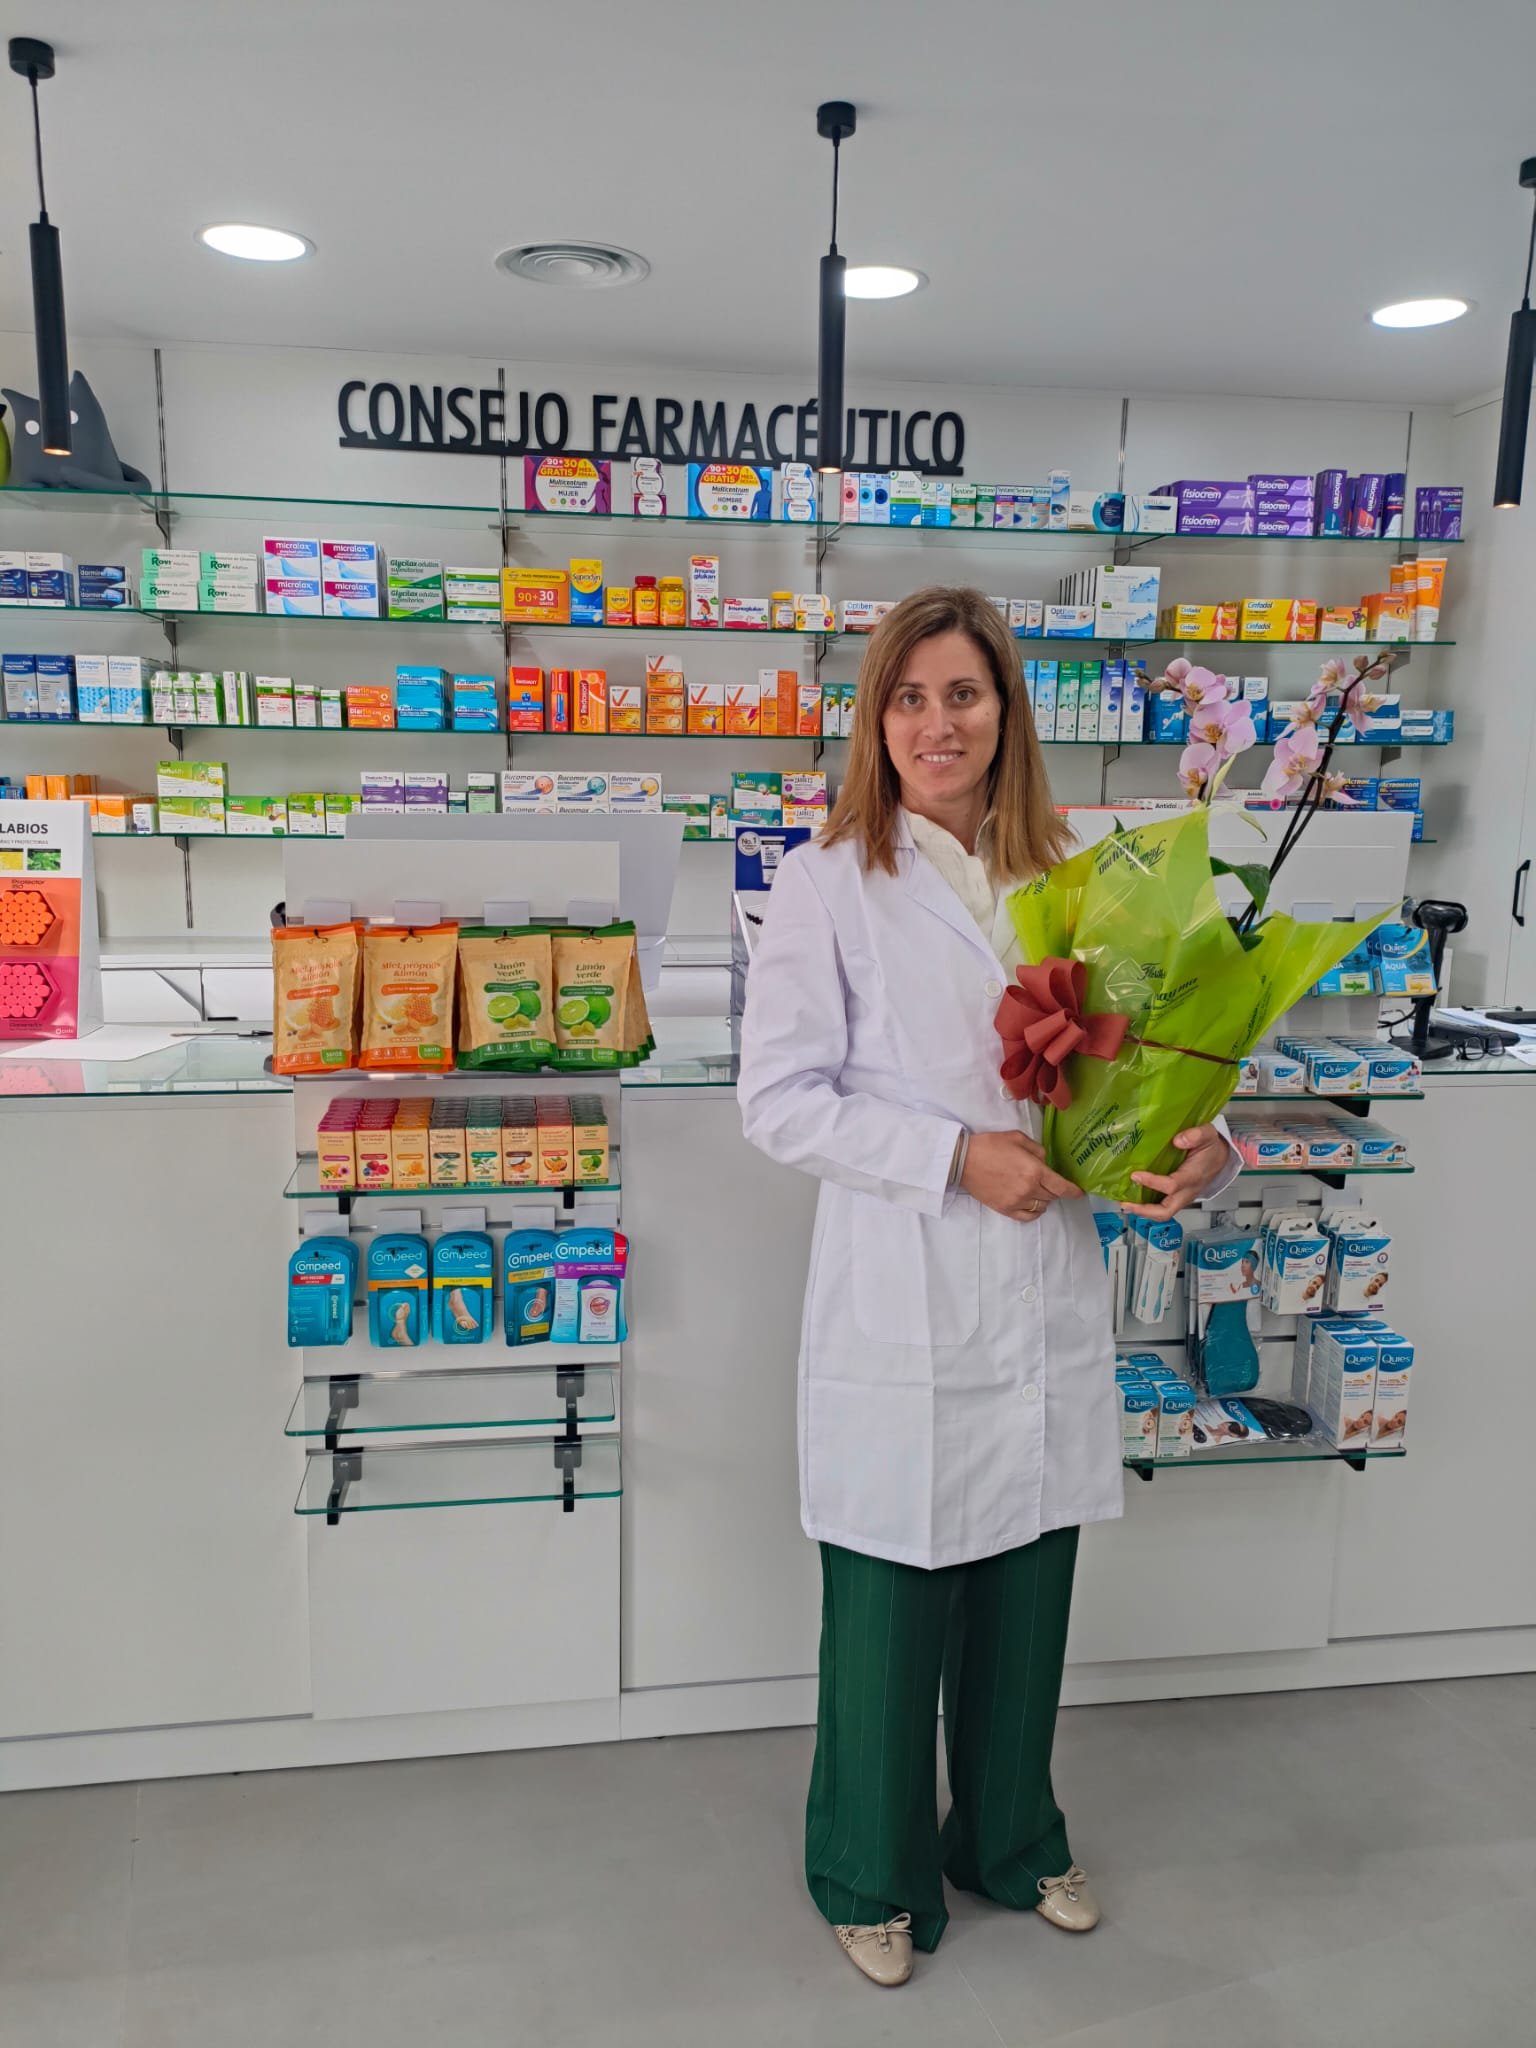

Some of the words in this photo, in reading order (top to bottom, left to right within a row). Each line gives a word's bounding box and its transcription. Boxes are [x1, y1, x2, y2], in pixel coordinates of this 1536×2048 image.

[338, 380, 569, 452] CONSEJO
[540, 467, 573, 476] GRATIS
[549, 478, 588, 487] Multicentrum
[703, 475, 736, 483] GRATIS
[1257, 479, 1289, 490] fisiocrem
[711, 485, 750, 494] Multicentrum
[1182, 487, 1222, 500] fisiocrem
[1332, 472, 1342, 510] fisiocrem
[1367, 477, 1379, 512] fisiocrem
[1258, 500, 1290, 511] fisiocrem
[1182, 514, 1221, 526] fisiocrem
[1258, 521, 1290, 532] fisiocrem
[847, 602, 873, 611] Optiben
[1247, 601, 1273, 609] Cinfadol
[1246, 622, 1271, 631] Cinfadol
[504, 774, 535, 782] Bucomax
[557, 774, 588, 782] Bucomax
[611, 775, 642, 783] Bucomax
[0, 823, 49, 835] LABIOS
[1382, 943, 1408, 953] Quies
[493, 960, 526, 971] Limón
[575, 962, 606, 972] Limón
[1385, 963, 1407, 971] AQUA
[496, 968, 525, 977] verde
[576, 971, 602, 979] verde
[1323, 1064, 1349, 1075] Quies
[1375, 1063, 1401, 1074] Quies
[1159, 1237, 1182, 1249] Quies
[437, 1247, 489, 1263] Compeed
[554, 1242, 612, 1260] Compeed
[1289, 1244, 1315, 1256] Quies
[1348, 1244, 1376, 1255] Quies
[371, 1250, 423, 1266] Compeed
[1204, 1247, 1239, 1264] Quies
[295, 1260, 342, 1275] Compeed
[1345, 1353, 1376, 1366] Quies
[1381, 1353, 1411, 1366] Quies
[1127, 1399, 1155, 1410] Quies
[1165, 1400, 1193, 1412] Quies
[1226, 1400, 1247, 1422] Quies
